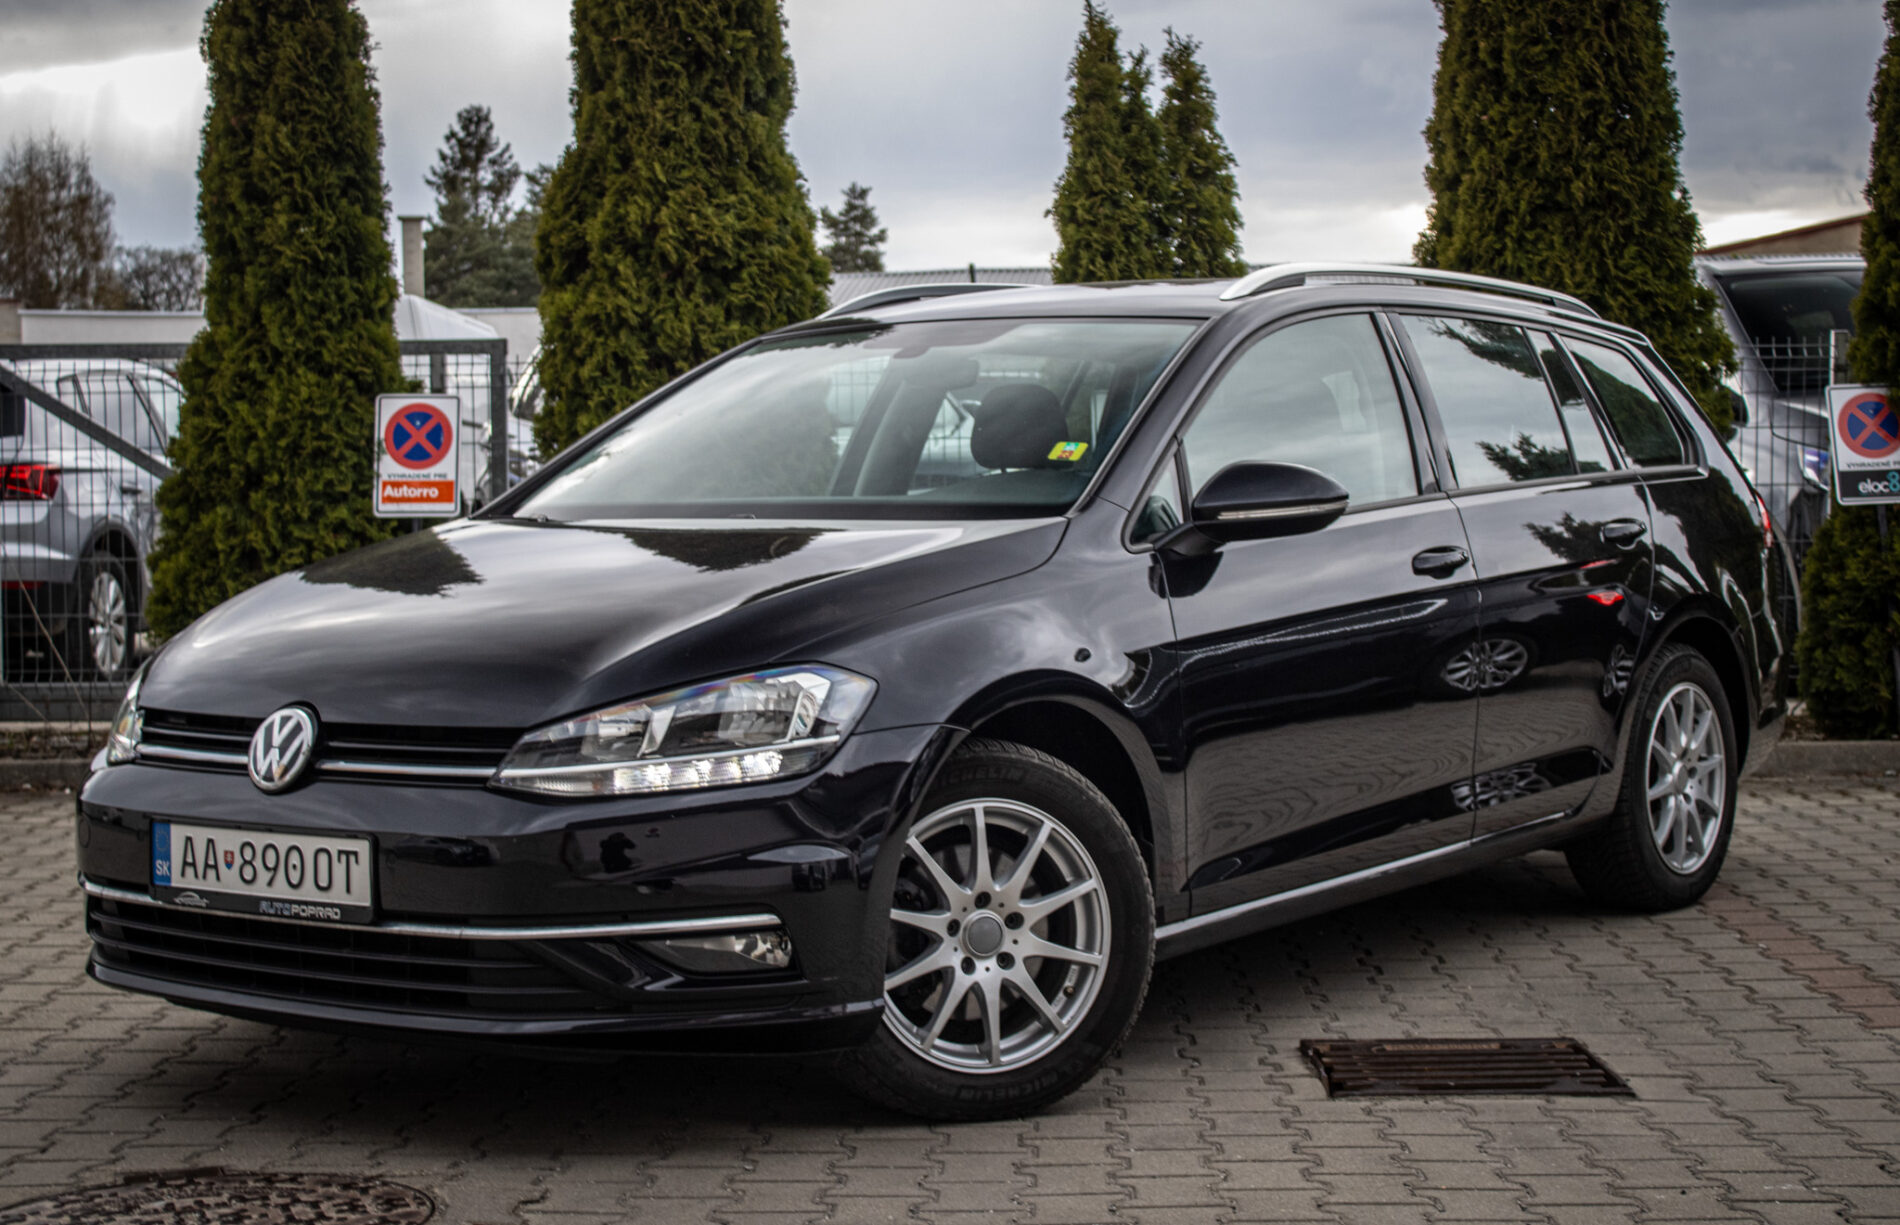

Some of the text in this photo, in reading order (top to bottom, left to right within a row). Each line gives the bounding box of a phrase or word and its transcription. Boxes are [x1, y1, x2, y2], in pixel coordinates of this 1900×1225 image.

[383, 484, 439, 498] Autorro
[1858, 471, 1900, 494] eloc8
[155, 860, 170, 877] SK
[181, 835, 221, 882] AA
